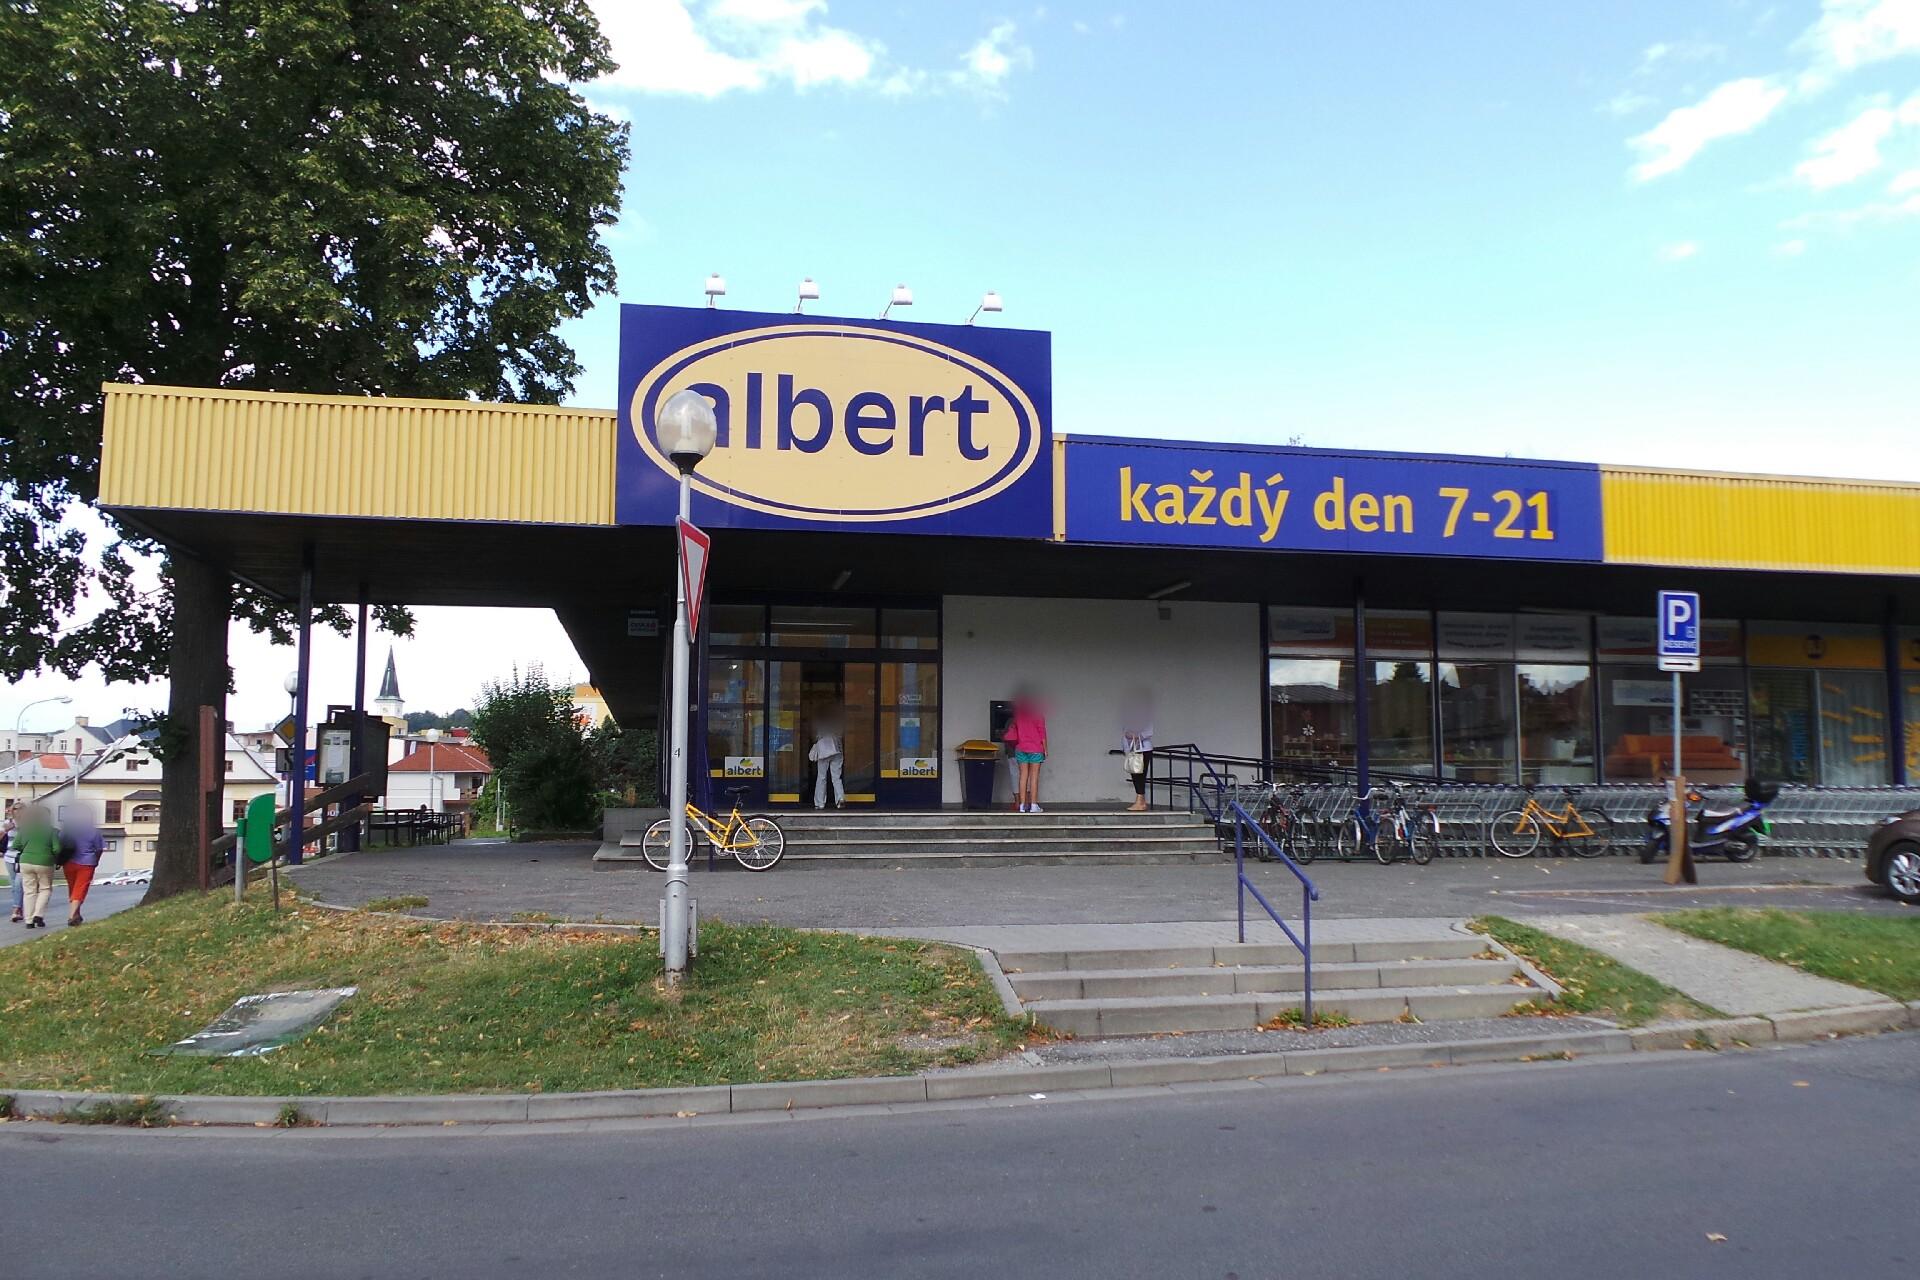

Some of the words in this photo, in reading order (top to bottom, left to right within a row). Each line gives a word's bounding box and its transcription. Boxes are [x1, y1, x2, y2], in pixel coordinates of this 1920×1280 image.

[1120, 466, 1290, 543] každý
[1313, 476, 1413, 534] den
[1438, 487, 1554, 540] 7-21
[1667, 599, 1691, 636] P
[727, 765, 761, 776] albert
[902, 766, 936, 776] albert
